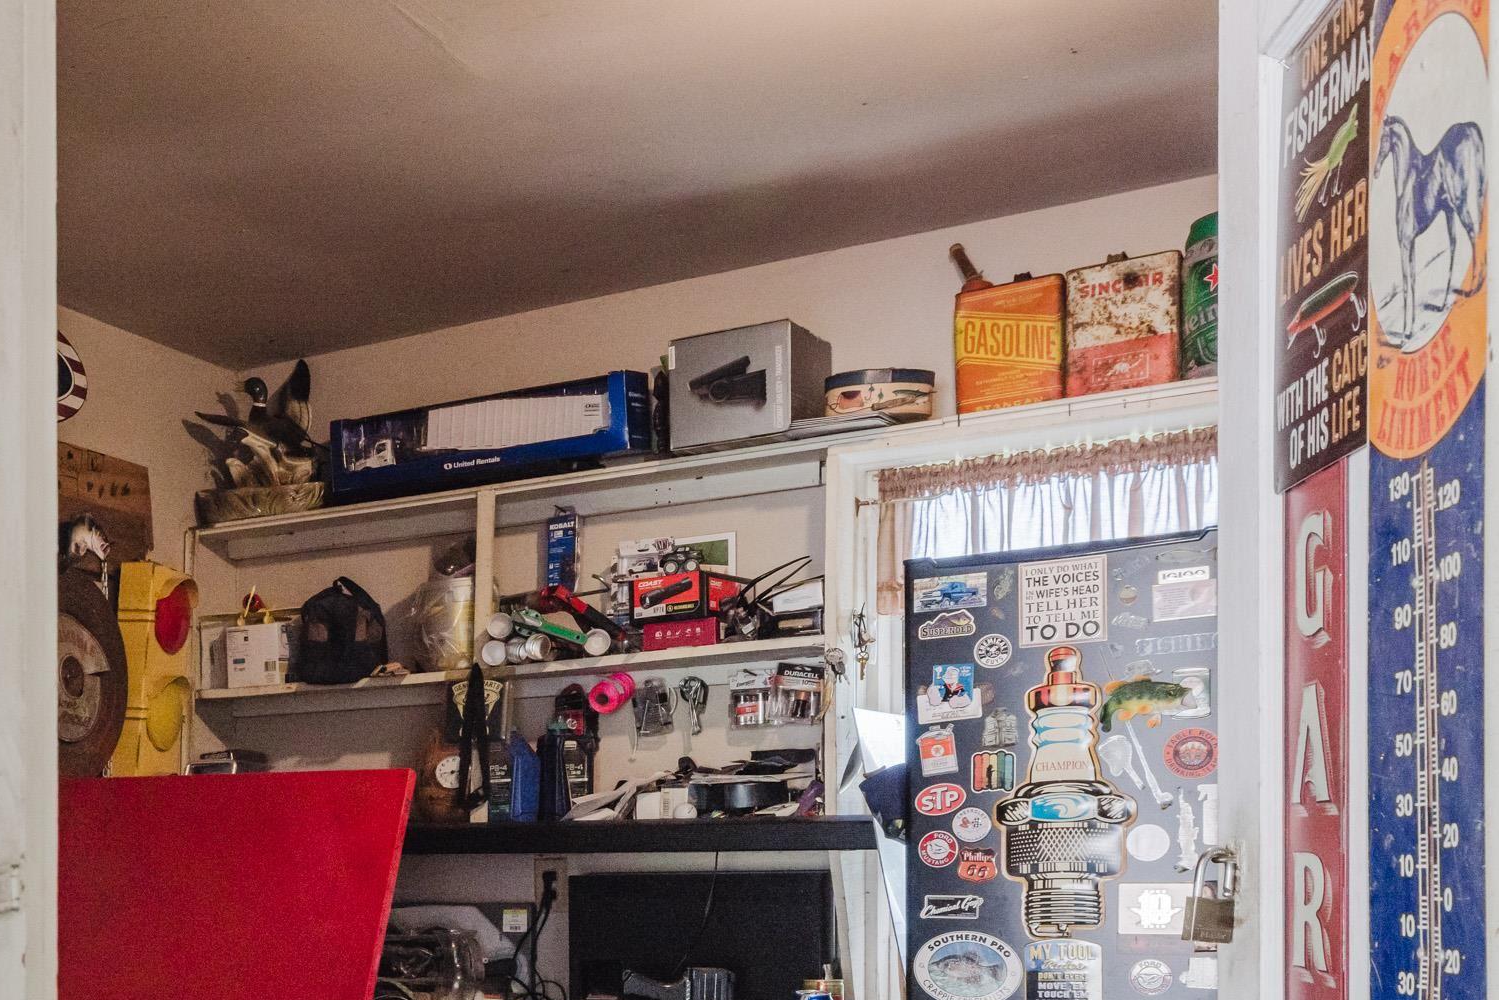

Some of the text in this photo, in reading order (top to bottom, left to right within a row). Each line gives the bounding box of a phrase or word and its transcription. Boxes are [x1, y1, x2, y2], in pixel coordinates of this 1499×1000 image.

[1302, 0, 1364, 90] ONE FINE
[1279, 225, 1322, 305] LIVES
[963, 320, 1056, 361] GASOLINE
[1393, 322, 1456, 401] HORSE
[1277, 377, 1304, 432] WITH
[1306, 357, 1329, 411] THE
[1376, 346, 1474, 451] LINIMENT
[1290, 386, 1361, 470] OF HIS LIFE
[453, 455, 501, 469] United Rentals
[1389, 472, 1410, 499] 130
[1438, 480, 1460, 509] 120
[549, 521, 575, 530] KOBALT
[1391, 538, 1411, 566] 110
[1025, 571, 1100, 587] THE VOICES
[1030, 566, 1054, 576] ONLY
[1056, 565, 1070, 573] DO
[1071, 562, 1099, 571] WHAT
[1440, 556, 1460, 581] 100
[1036, 584, 1100, 599] WIFE'S HEAD
[1025, 596, 1099, 613] TELL HER
[1025, 609, 1099, 625] TO TELL ME
[1394, 604, 1411, 629] 90
[922, 625, 973, 637] SUSPENDED
[1025, 624, 1057, 642] TO
[1065, 620, 1100, 639] DO
[1440, 622, 1457, 647] 80
[784, 669, 819, 679] DURACELL
[1395, 672, 1412, 695] 70
[1441, 690, 1457, 714] 60
[1395, 734, 1412, 757] 50
[1035, 760, 1089, 772] CHAMPION
[1442, 757, 1458, 782] 40
[921, 786, 959, 811] STP
[1396, 794, 1413, 816] 30
[933, 832, 954, 844] FORD
[1443, 823, 1459, 848] 20
[921, 849, 950, 865] MUSTANG
[1399, 855, 1414, 877] 10
[967, 864, 988, 878] 66
[1444, 888, 1452, 912] 0
[1400, 915, 1415, 937] 10
[927, 933, 1012, 958] SOUTHERN PRO
[1029, 943, 1097, 960] MY TOOL
[1444, 949, 1460, 975] 20
[1037, 982, 1065, 990] MOVE
[1037, 990, 1069, 998] TOUCH
[1398, 973, 1415, 996] 30
